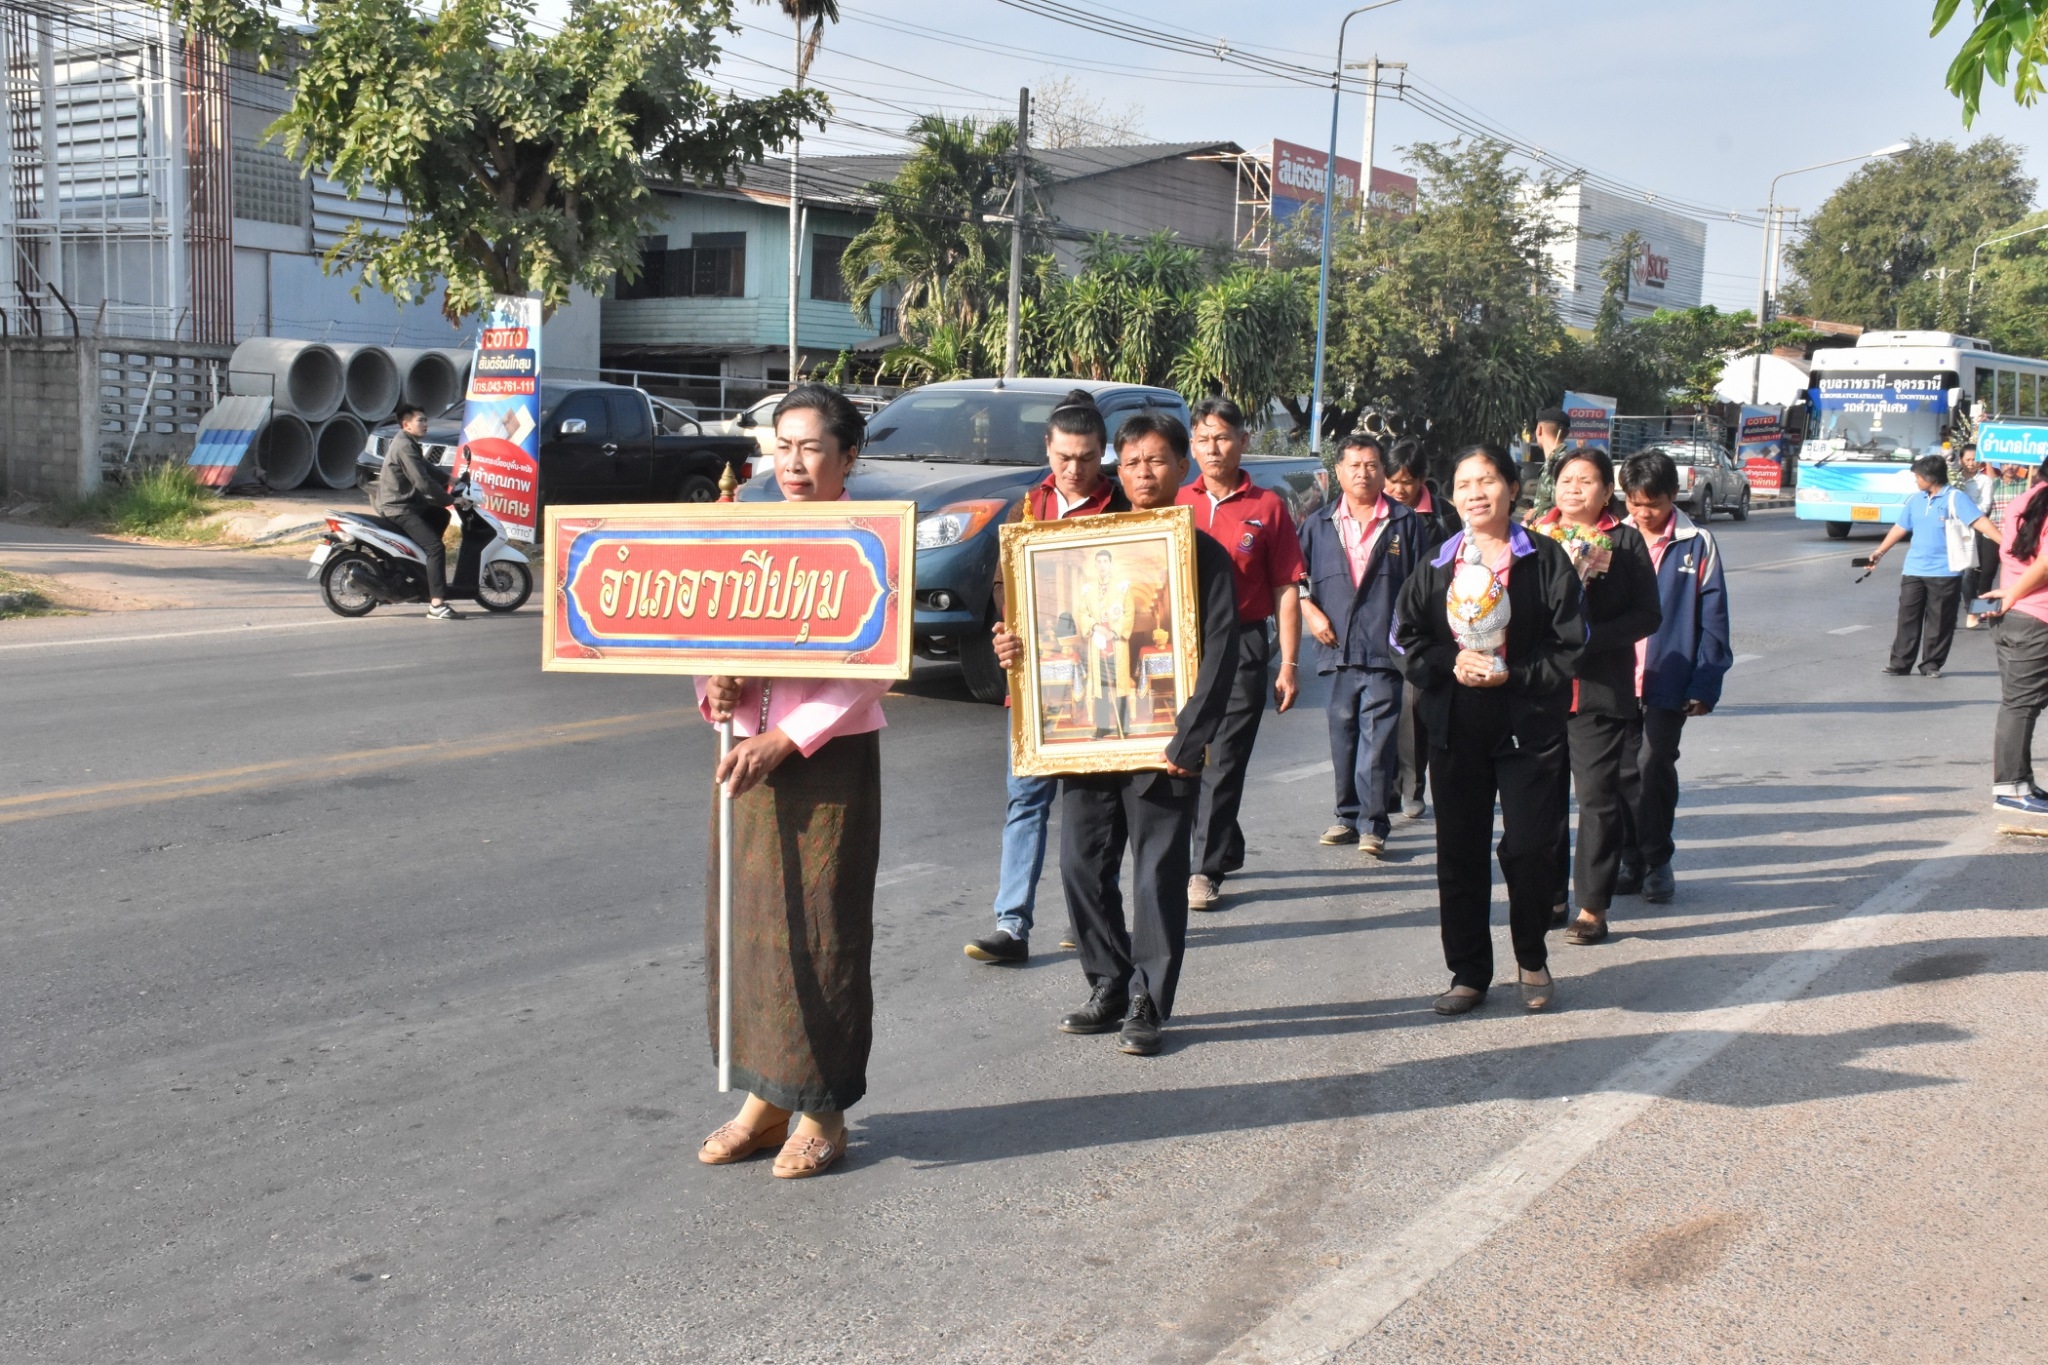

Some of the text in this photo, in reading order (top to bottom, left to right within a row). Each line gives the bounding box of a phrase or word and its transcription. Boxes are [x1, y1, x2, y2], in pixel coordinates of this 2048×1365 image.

[485, 331, 524, 348] COTTO
[1571, 409, 1603, 418] COTTO
[1746, 416, 1774, 425] COTTO
[599, 545, 850, 645] อำเภอวาปีปทุม
